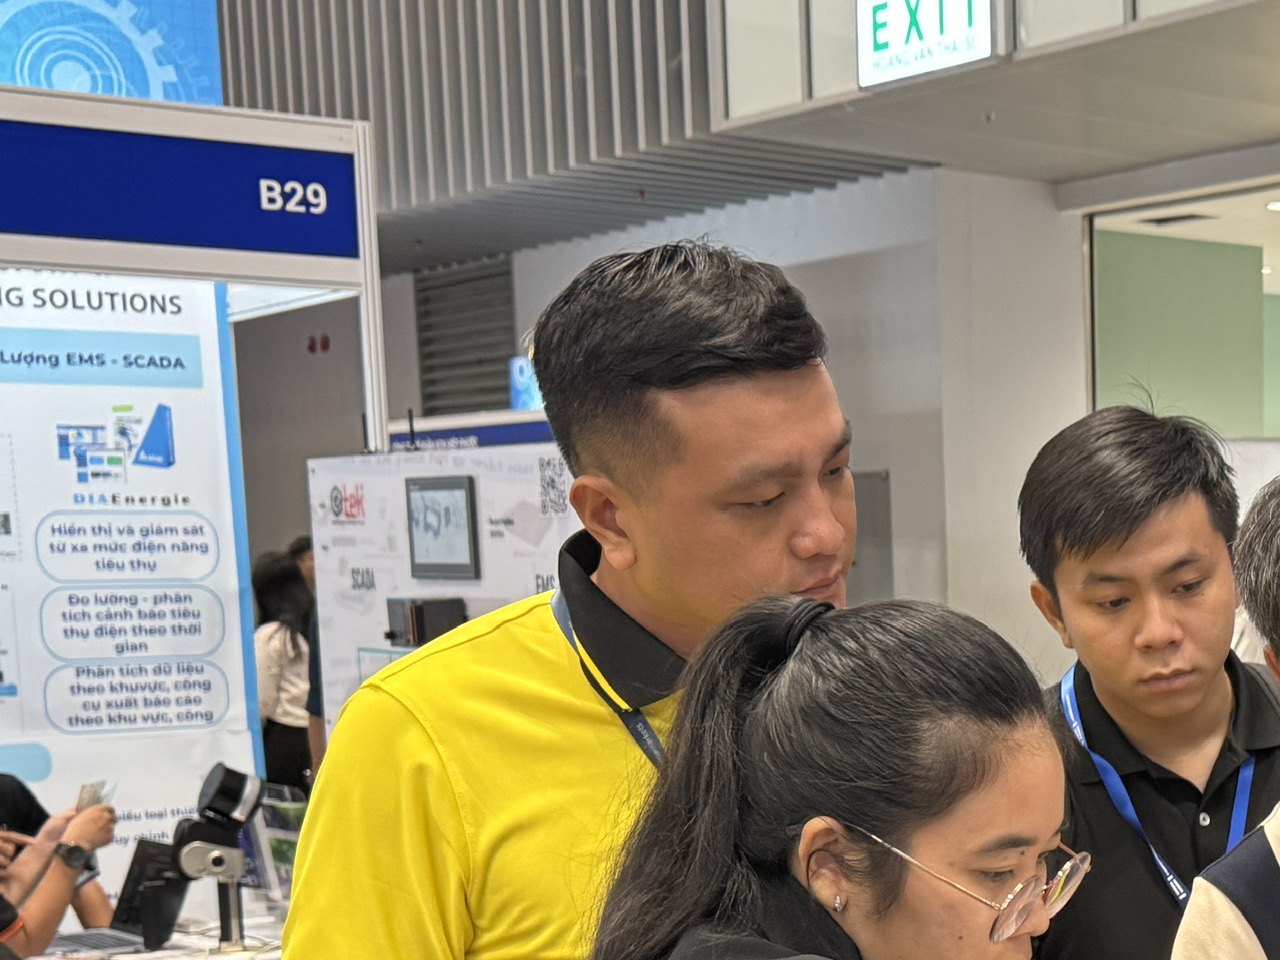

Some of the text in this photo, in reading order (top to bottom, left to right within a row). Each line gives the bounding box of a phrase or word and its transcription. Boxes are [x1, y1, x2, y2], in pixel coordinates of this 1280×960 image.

[259, 178, 328, 215] B29
[32, 287, 183, 315] SOLUTIONS
[66, 351, 106, 368] EMS
[123, 354, 186, 371] SCADA
[352, 567, 377, 590] SCADA
